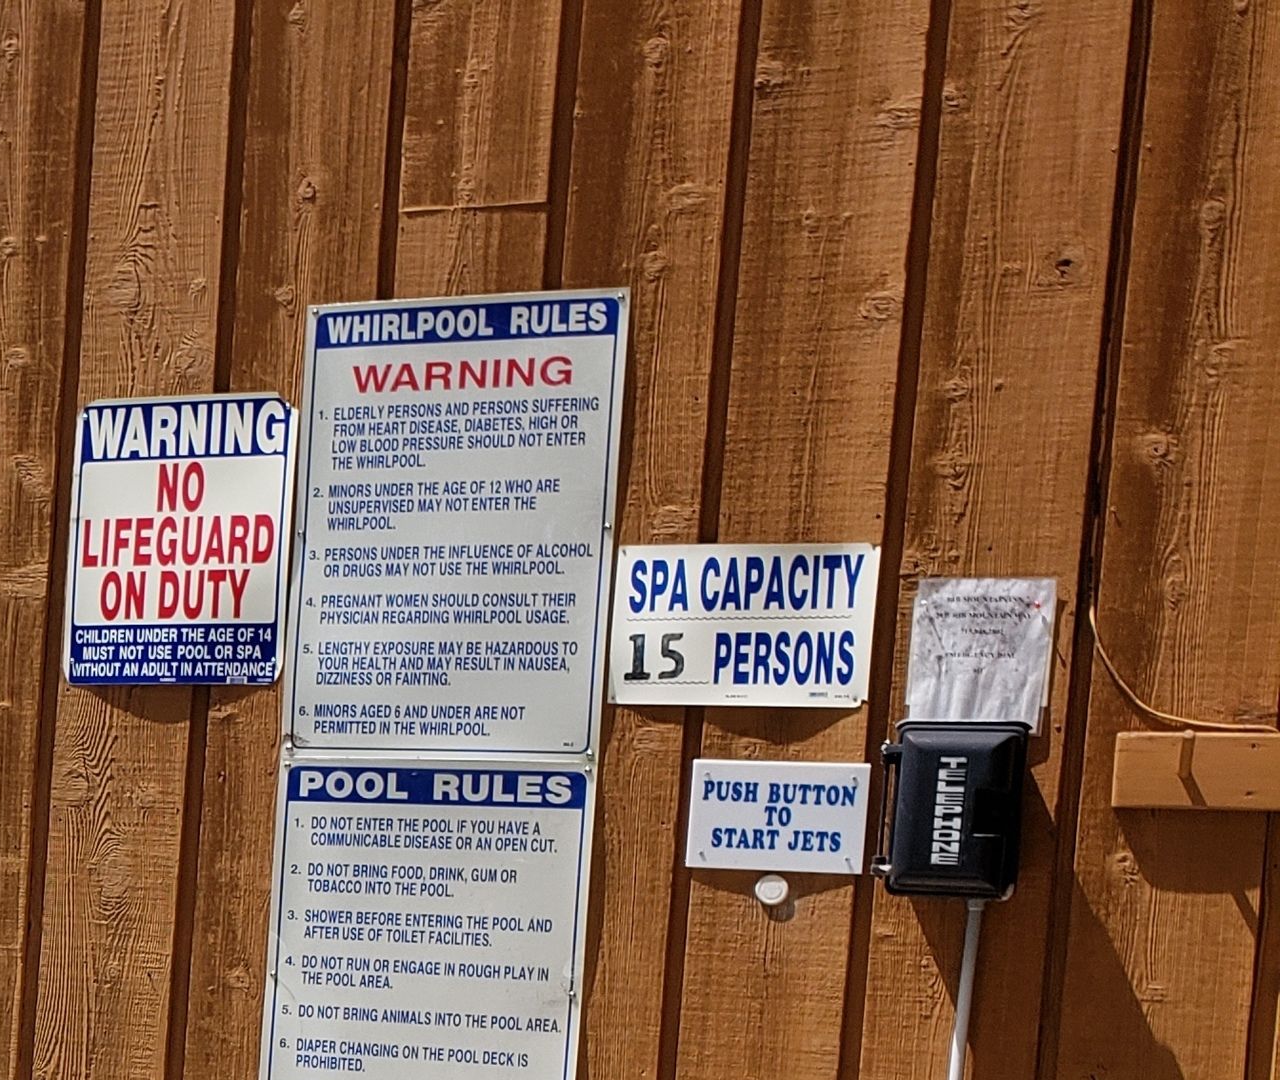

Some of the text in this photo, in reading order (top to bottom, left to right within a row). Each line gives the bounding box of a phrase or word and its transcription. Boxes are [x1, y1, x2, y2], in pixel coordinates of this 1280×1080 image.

[327, 302, 608, 344] WHIRLPOOL RULES
[353, 356, 574, 394] WARNING
[319, 397, 599, 420] 1. ELDERLY PERSONS AND PERSONS SUFFERING
[89, 400, 286, 460] WARNING
[333, 414, 578, 436] FROM HEART DISEASE, DIABETES, HIGH OR
[331, 431, 586, 453] LOW BLOOD PRESSURE SHOULD NOT ENTER
[332, 453, 426, 469] THE WHIRLPOOL.
[157, 462, 205, 512] NO
[313, 478, 560, 498] 2. MINORS UNDER THE AGE OF 12 WHO ARE
[328, 496, 536, 514] UNSUPERVISED MAY NOT ENTER THE
[327, 516, 397, 530] WHIRLPOOL.
[82, 514, 274, 568] LIFEGUARD
[628, 554, 865, 613] SPA CAPACITY
[100, 569, 251, 621] ON DUTY
[306, 592, 576, 607] 4. PREGNANT WOMEN SHOULD CONSULT THEIR
[319, 609, 570, 624] PHYSICIAN REGARDING WHIRLPOOL USAGE.
[76, 628, 272, 644] CHILDREN UNDER THE AGE OF 14
[83, 645, 262, 660] MUST NOT USE POOL OR SPA
[624, 632, 855, 686] 15 PERSONS
[72, 662, 273, 676] WITHOUT AN ADULT IN ATTENDANCE
[298, 704, 525, 719] 6. MINORS AGED 6 AND UNDER ARE NOT
[313, 720, 491, 735] PERMITTED IN THE WHIRLPOOL.
[298, 772, 572, 805] POOL RULES
[703, 781, 857, 807] PUSH BUTTON
[765, 806, 792, 827] TO
[931, 757, 967, 864] TELEPHONE
[295, 816, 540, 835] 1. DO NOT ENTER THE POOL IF YOU HAVE A
[310, 832, 558, 852] COMMUNICABLE DISEASE OR AN OPEN CUT.
[711, 828, 842, 852] START JETS
[290, 862, 517, 882] 2. DO NOT BRING FOOD, DRINK, GUM OR
[308, 879, 455, 897] TOBACCO INTO THE POOL.
[281, 1004, 562, 1032] 5. DO NOT BRING ANIMALS INTO THE POOL AREA.
